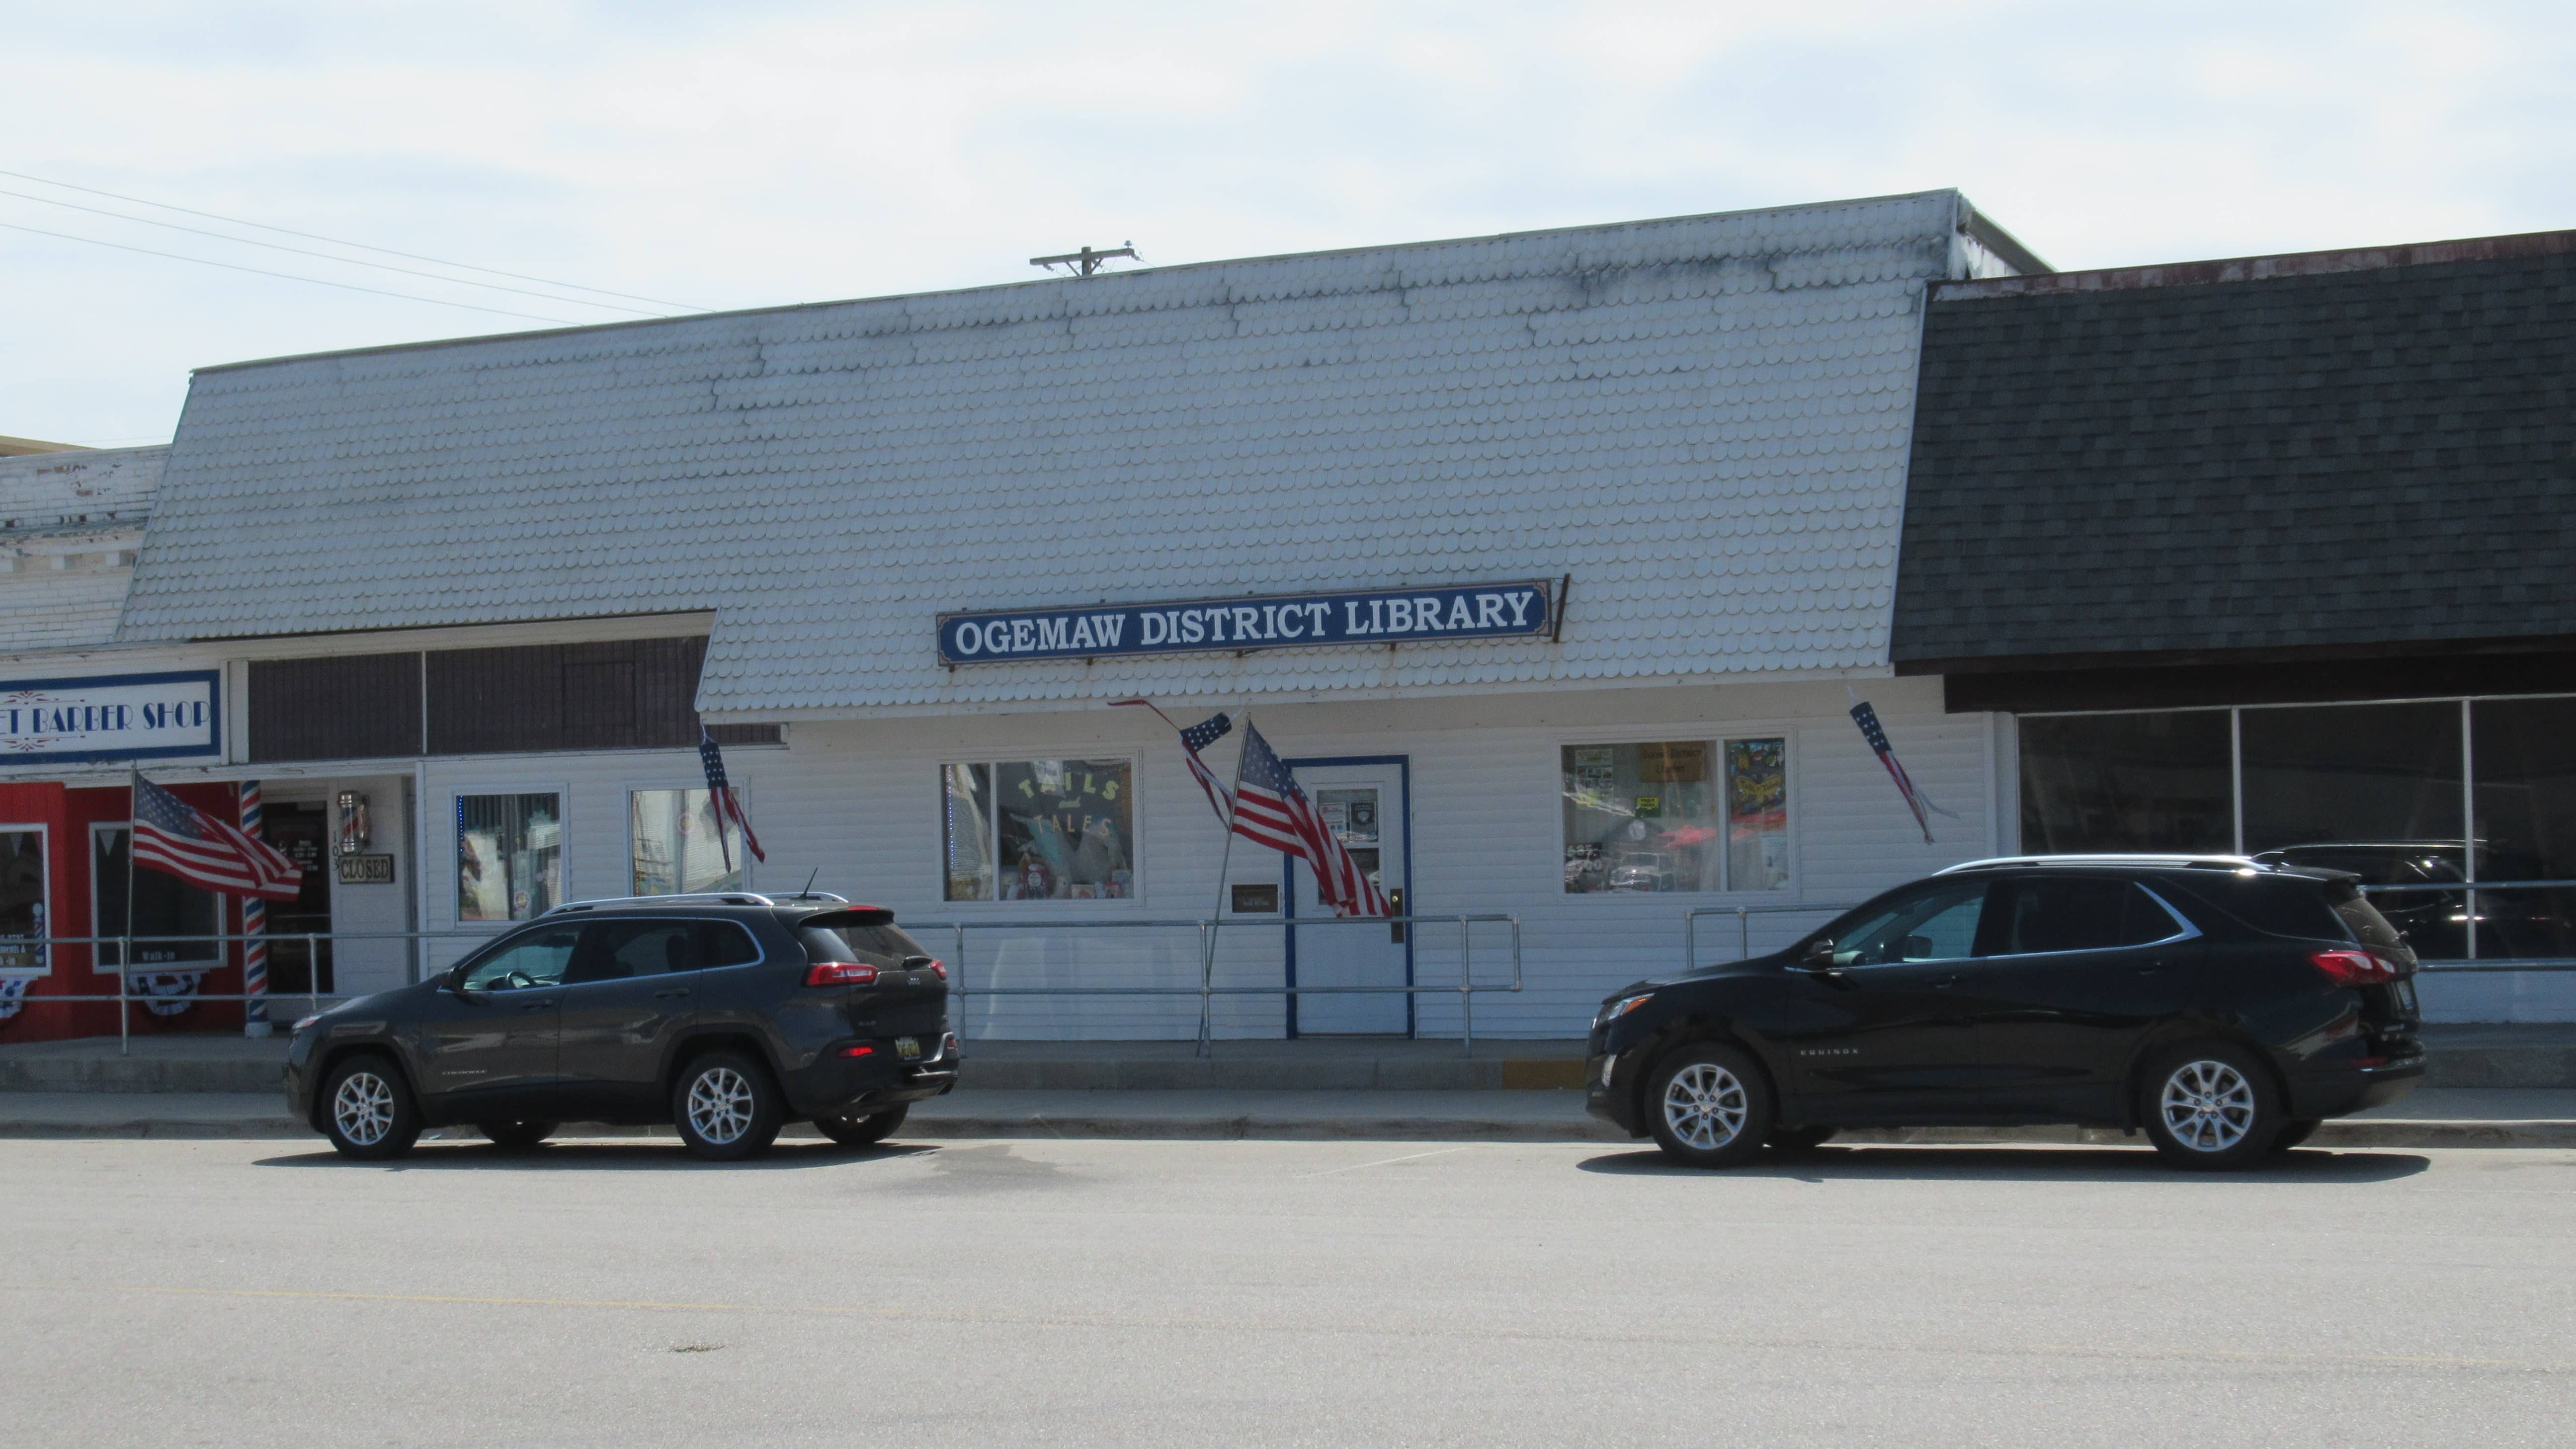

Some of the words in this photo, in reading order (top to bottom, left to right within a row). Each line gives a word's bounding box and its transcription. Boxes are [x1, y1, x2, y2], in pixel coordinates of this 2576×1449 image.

[956, 614, 1125, 654] OGEMAW
[1140, 602, 1331, 645] DISTRICT
[1345, 592, 1533, 635] LIBRARY
[33, 705, 133, 733] BARBER
[143, 701, 210, 729] SHOP
[1018, 772, 1119, 801] TAILS
[1033, 813, 1111, 836] TALES
[341, 859, 388, 879] CLOSED
